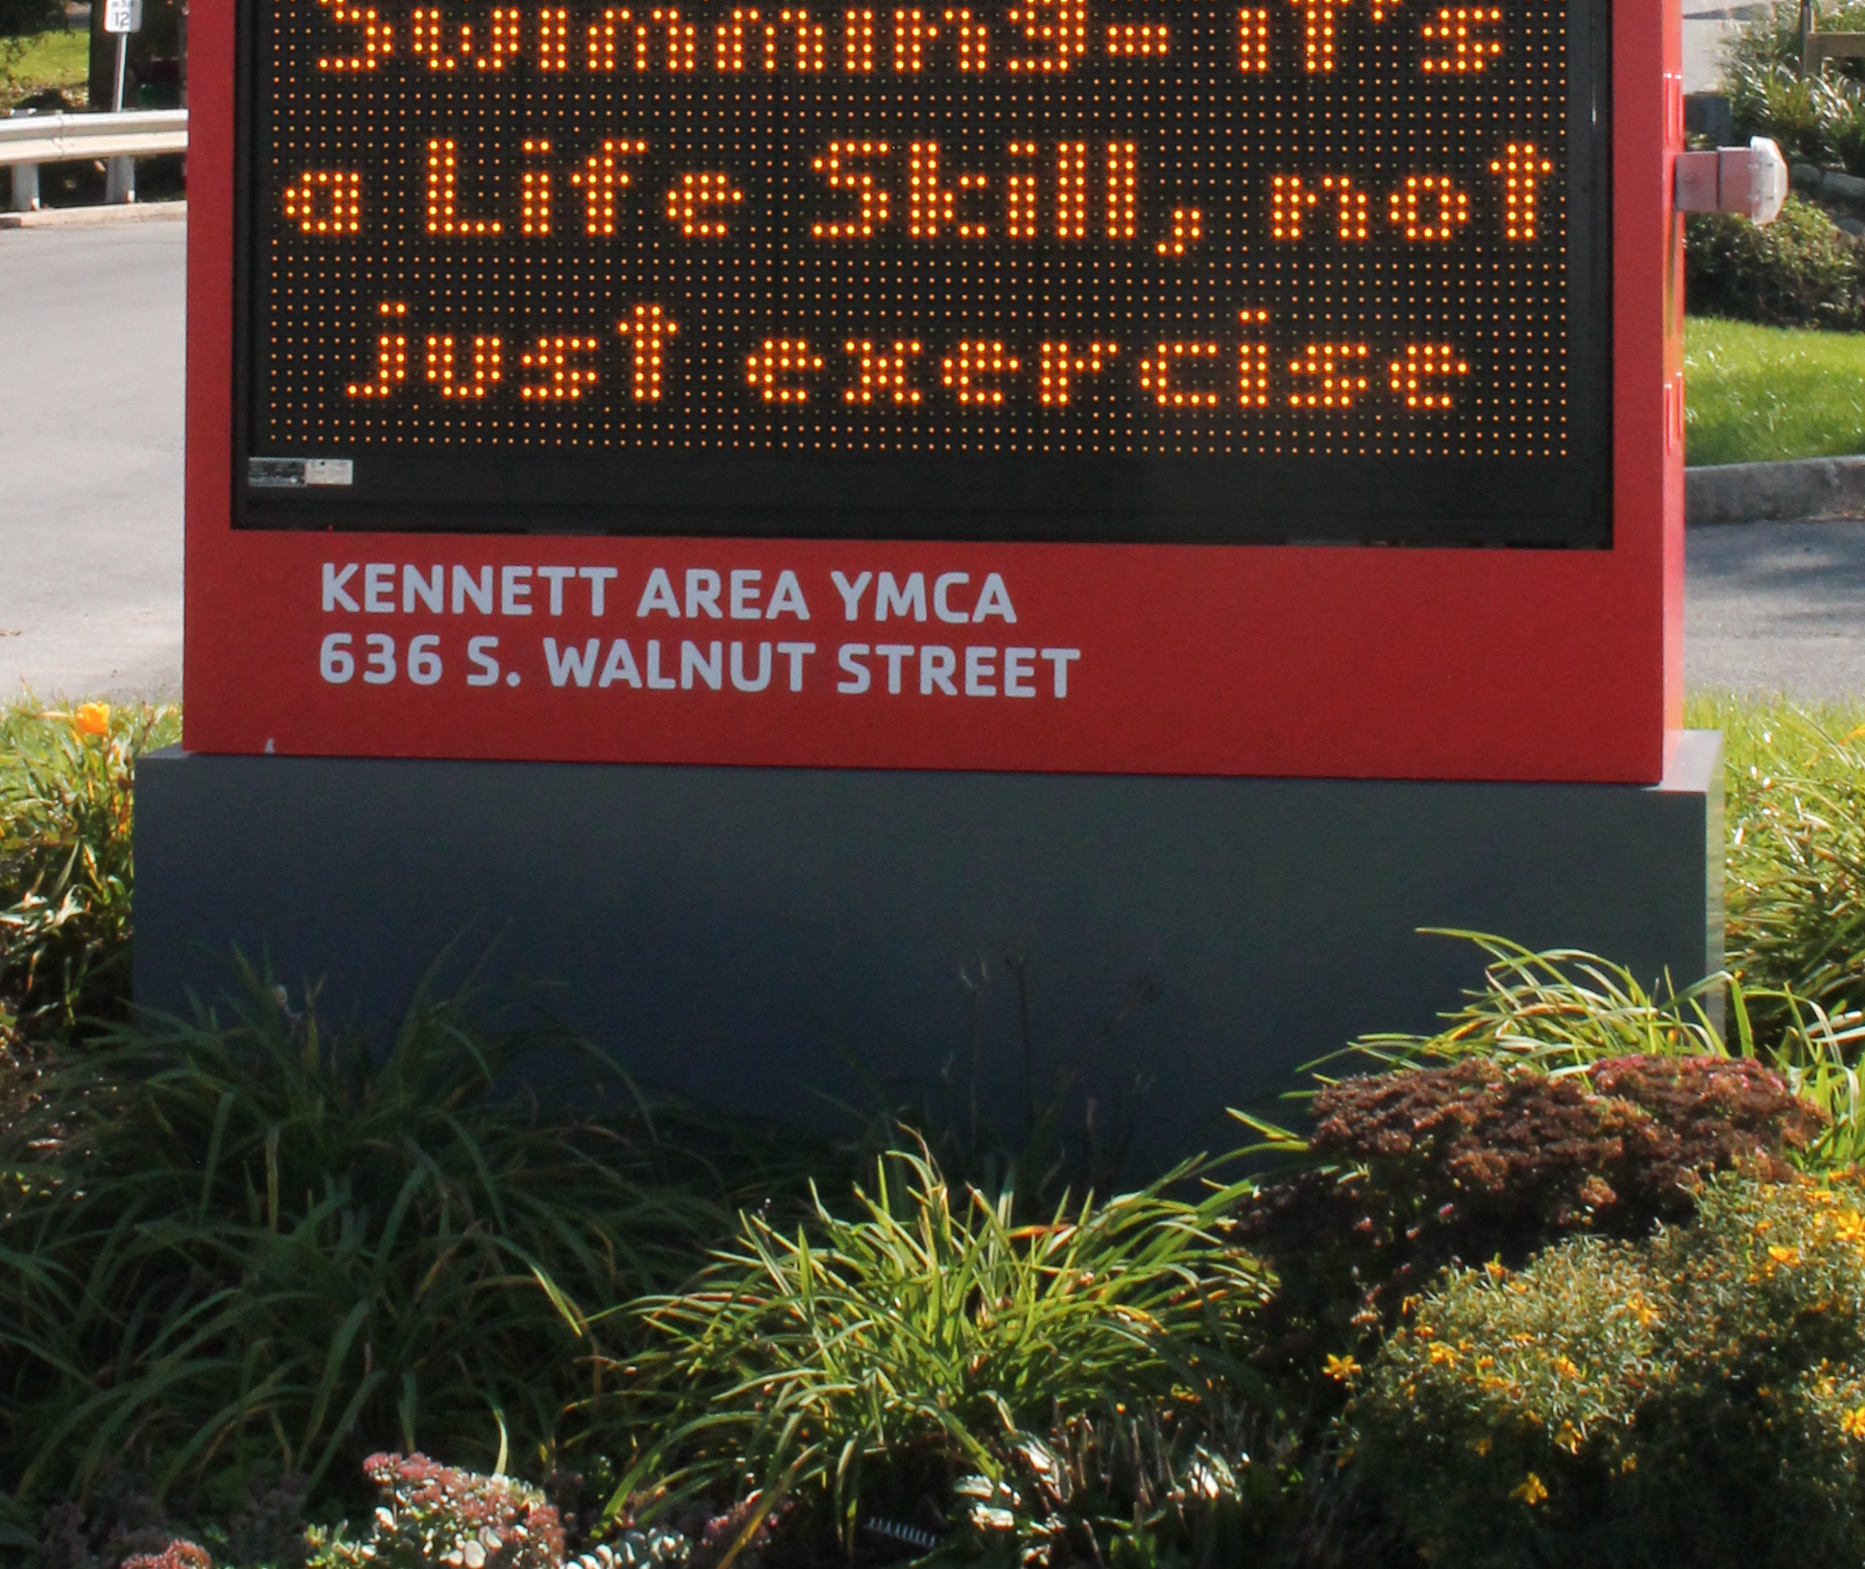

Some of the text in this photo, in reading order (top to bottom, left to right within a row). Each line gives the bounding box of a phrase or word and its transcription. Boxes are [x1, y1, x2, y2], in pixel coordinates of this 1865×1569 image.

[282, 138, 1554, 257] a Life Skill, not
[345, 301, 1470, 410] just exercise
[321, 562, 1017, 624] KENNETT AREA YMCA
[319, 632, 1081, 699] 636 S. WALNUT STREET
